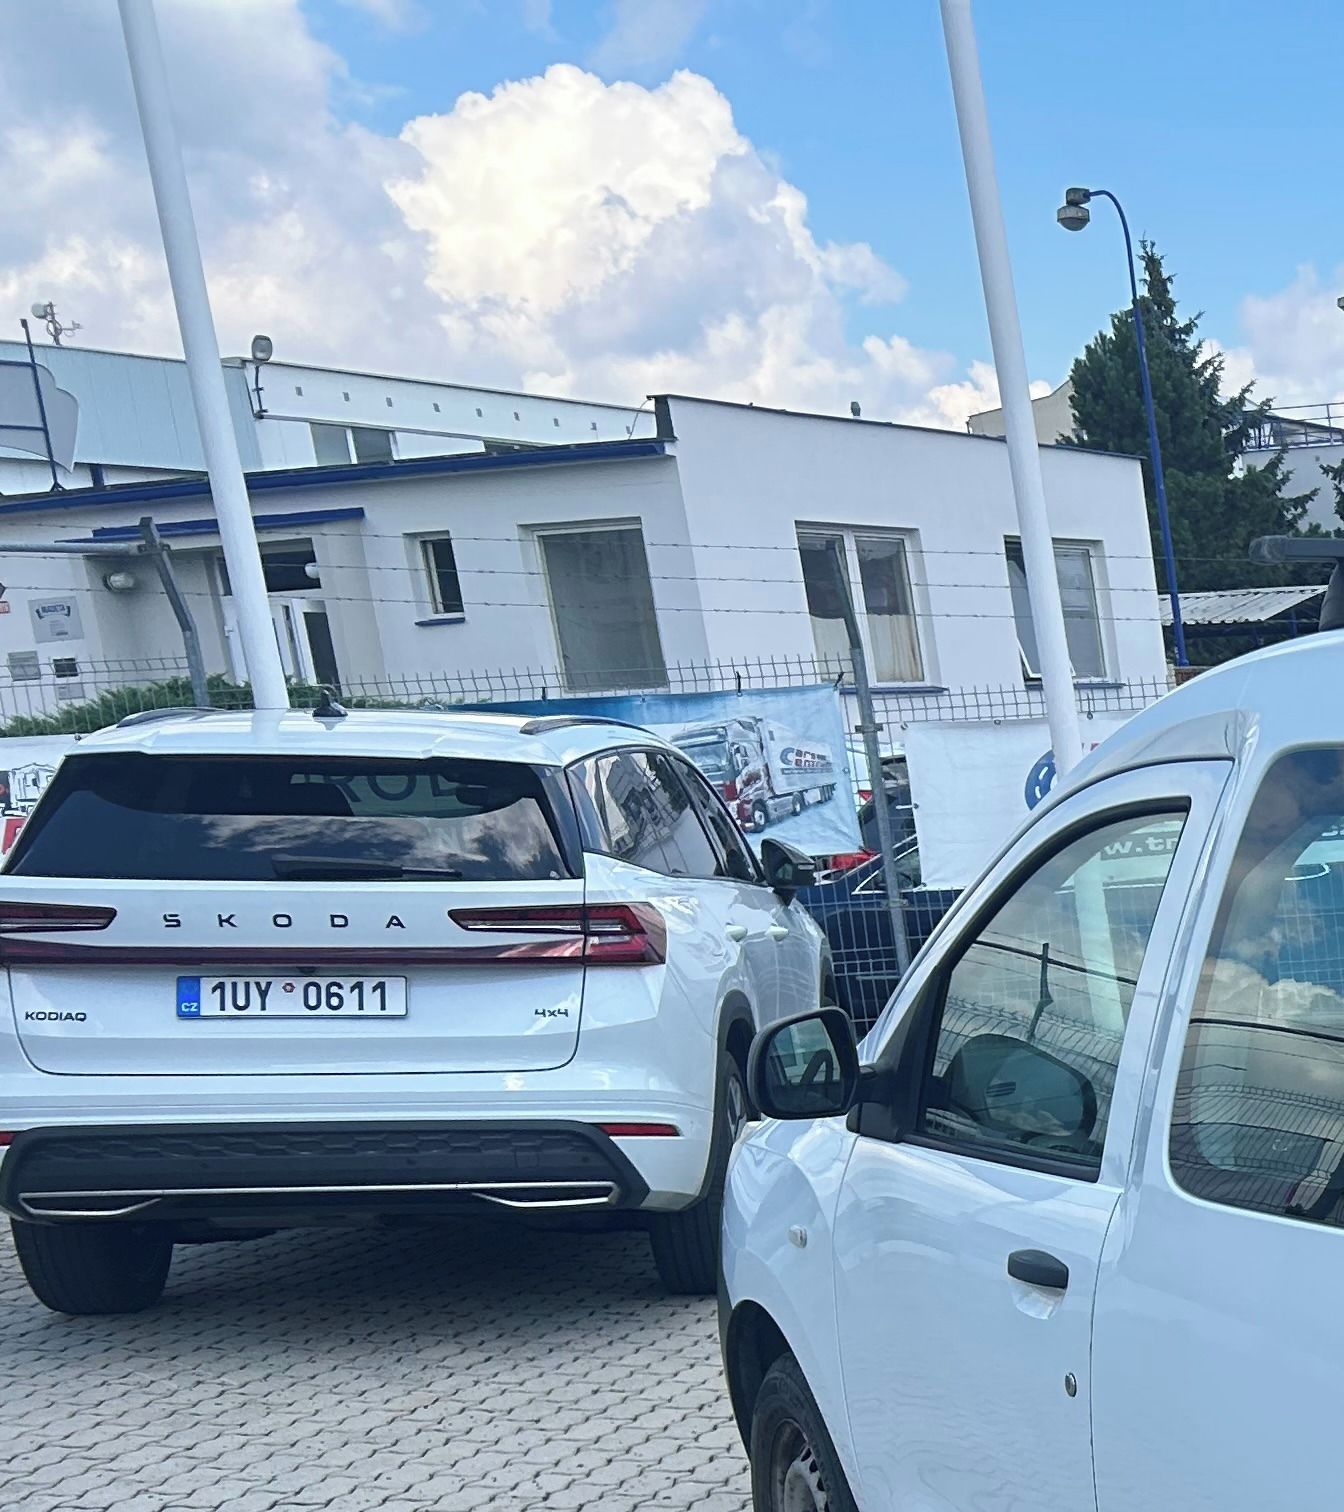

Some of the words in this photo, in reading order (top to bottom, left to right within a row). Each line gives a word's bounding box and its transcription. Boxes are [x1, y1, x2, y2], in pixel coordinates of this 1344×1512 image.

[210, 980, 272, 1012] 1UY
[302, 980, 388, 1012] 0611
[181, 1002, 198, 1012] CZ
[25, 1011, 87, 1022] KODIAQ
[534, 1008, 569, 1018] 4x4
